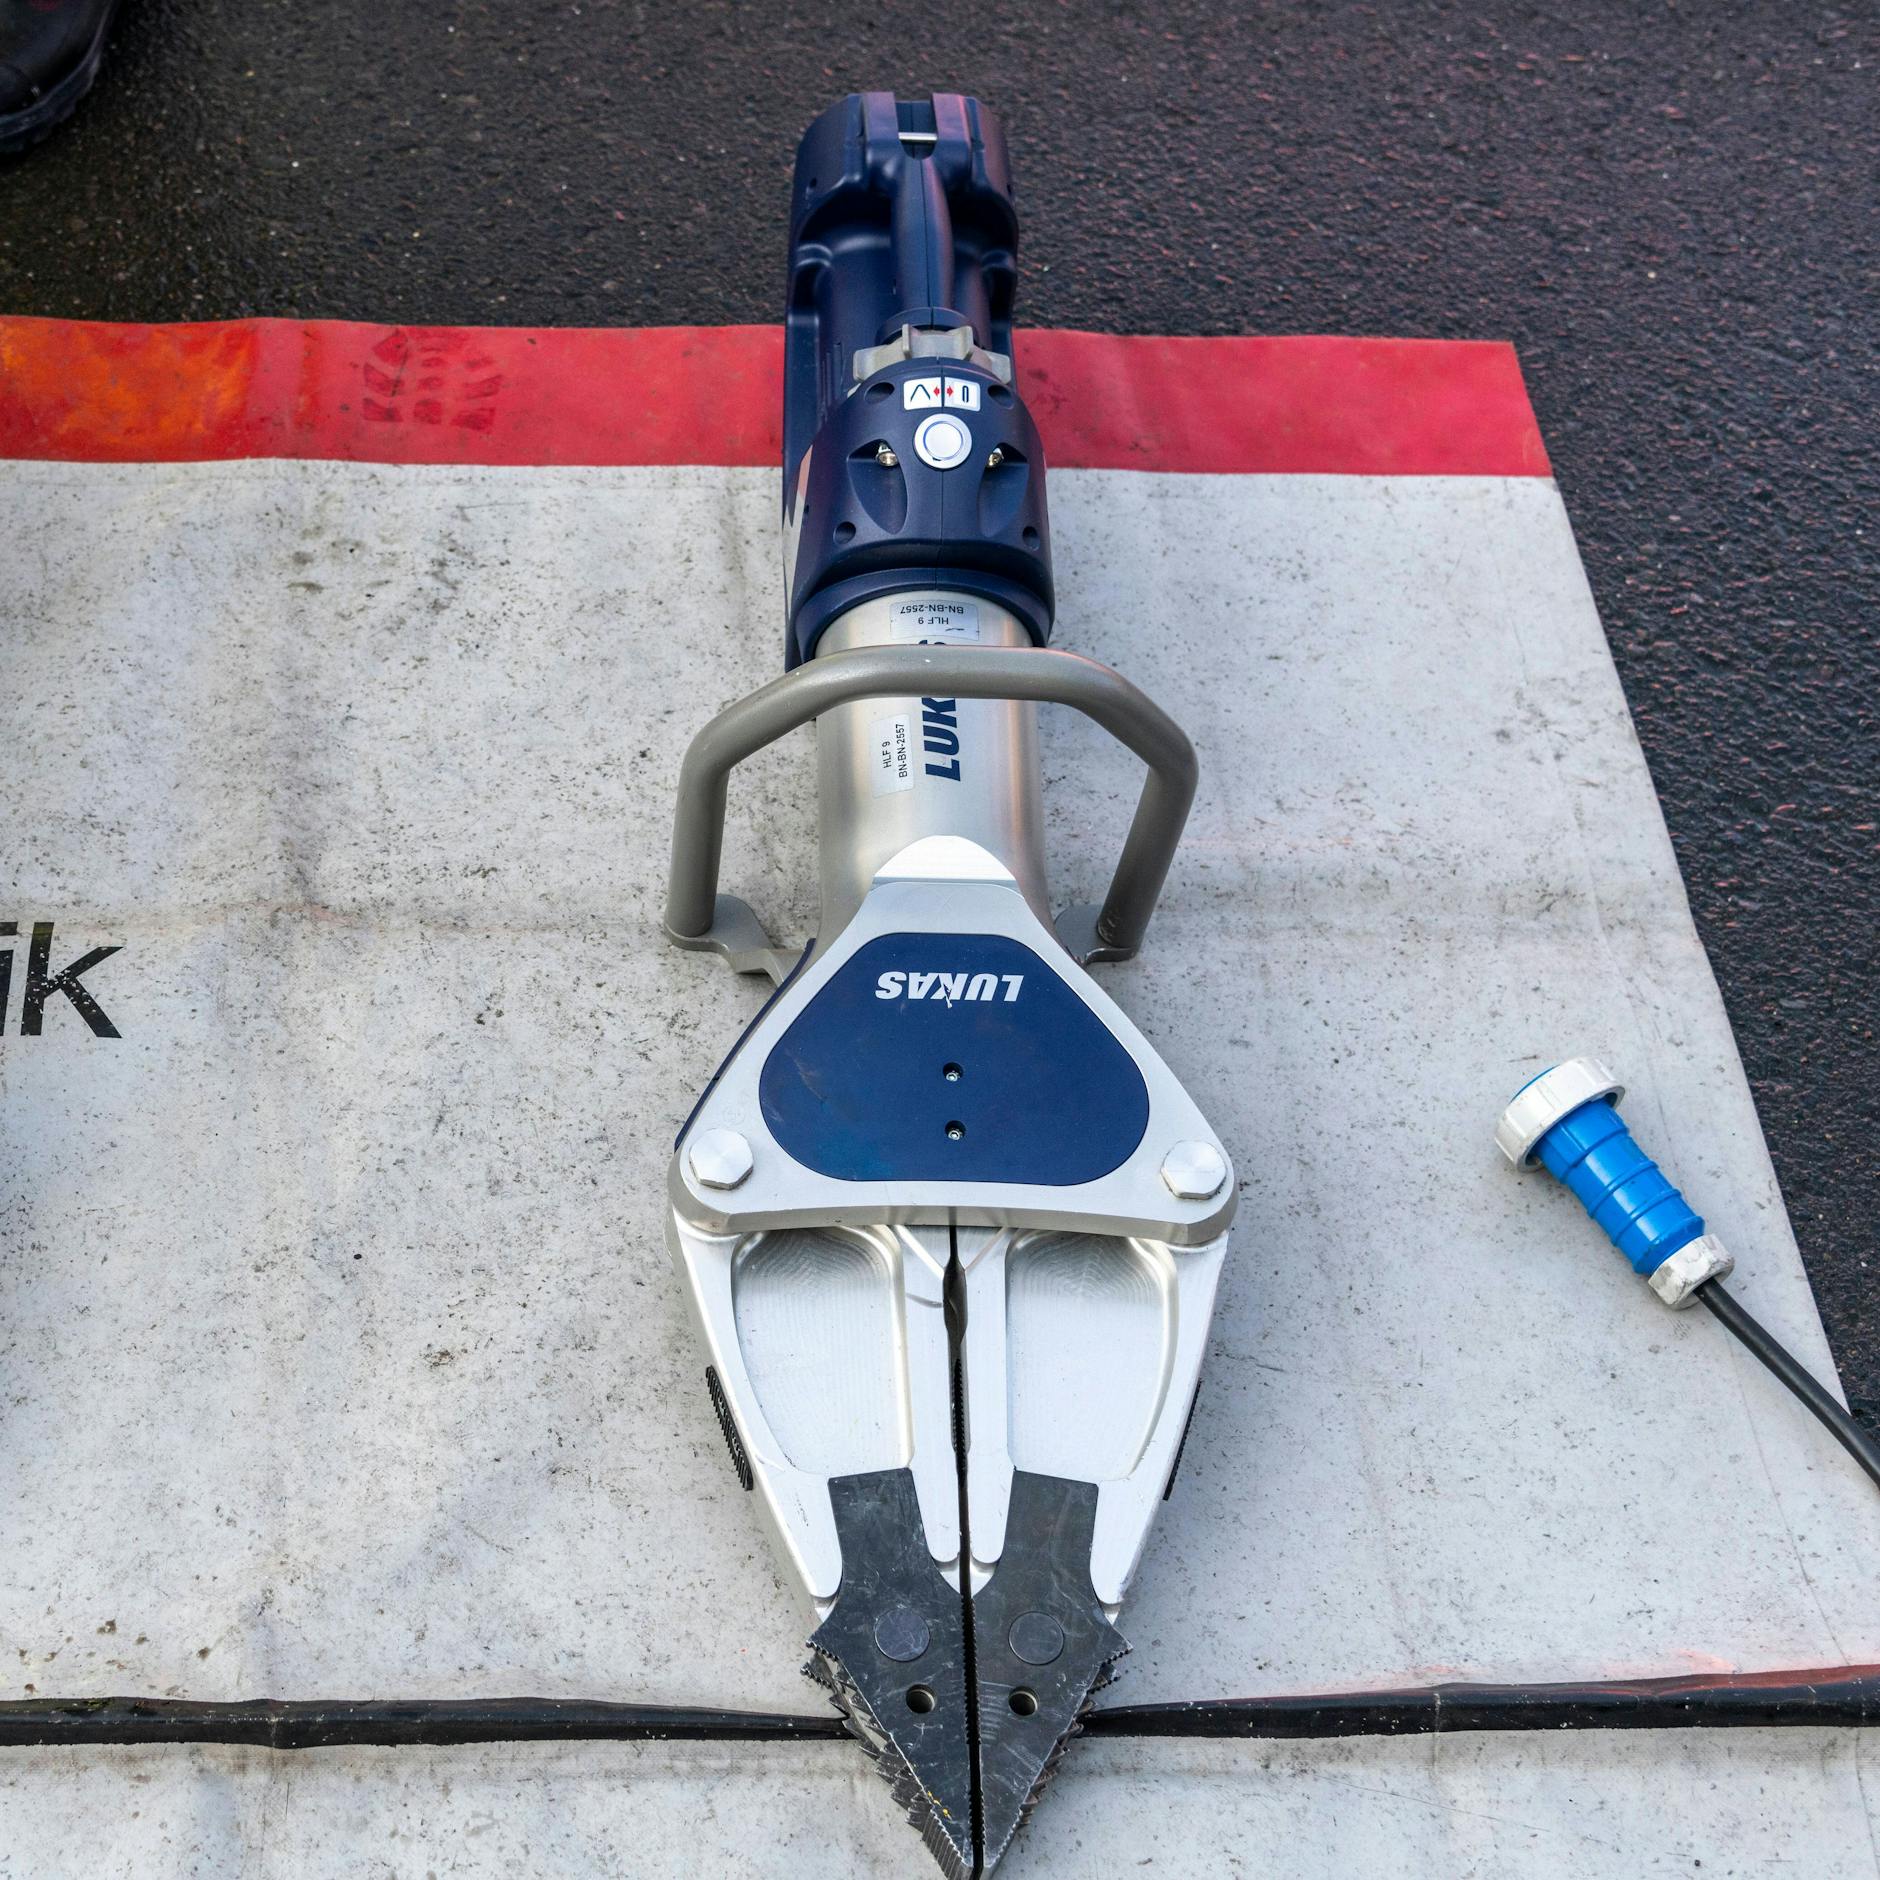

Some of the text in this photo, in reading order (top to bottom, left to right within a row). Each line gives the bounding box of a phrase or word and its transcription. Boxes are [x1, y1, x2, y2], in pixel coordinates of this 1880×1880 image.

[899, 604, 964, 615] BN-BN-2557
[917, 616, 949, 625] HLF 9
[920, 639, 961, 782] LUK
[881, 740, 892, 769] HLF 9
[895, 723, 908, 779] BN-BN-2557
[875, 971, 1024, 1004] LUKAS
